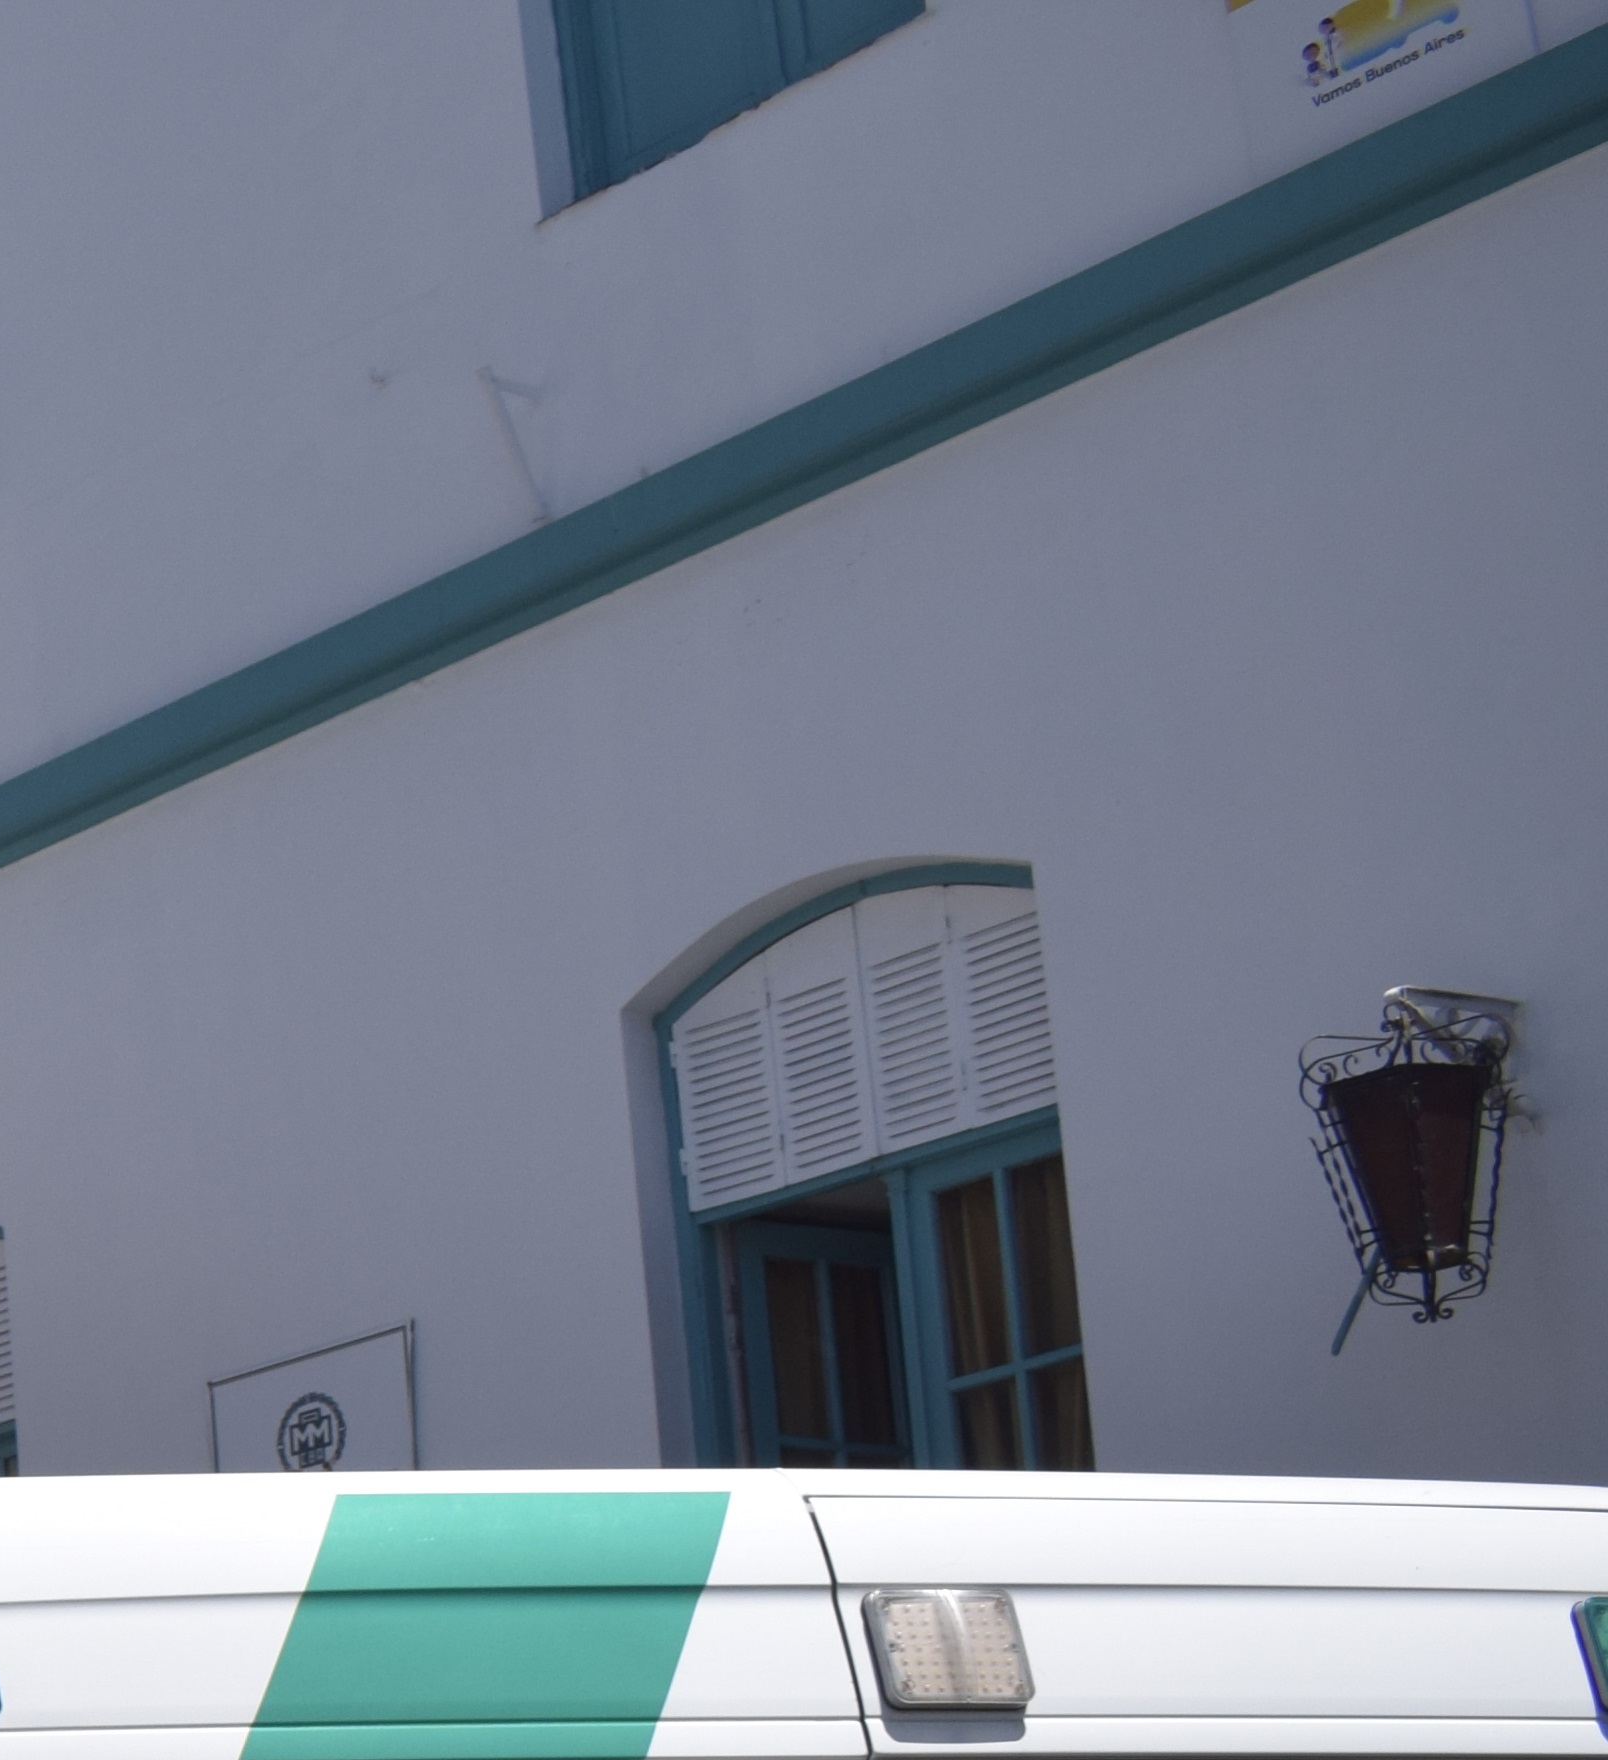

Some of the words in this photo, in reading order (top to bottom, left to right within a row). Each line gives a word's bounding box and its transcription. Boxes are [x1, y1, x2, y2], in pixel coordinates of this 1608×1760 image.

[1312, 77, 1362, 108] Vamos
[1365, 51, 1420, 83] Buenos
[1423, 27, 1466, 55] Aires
